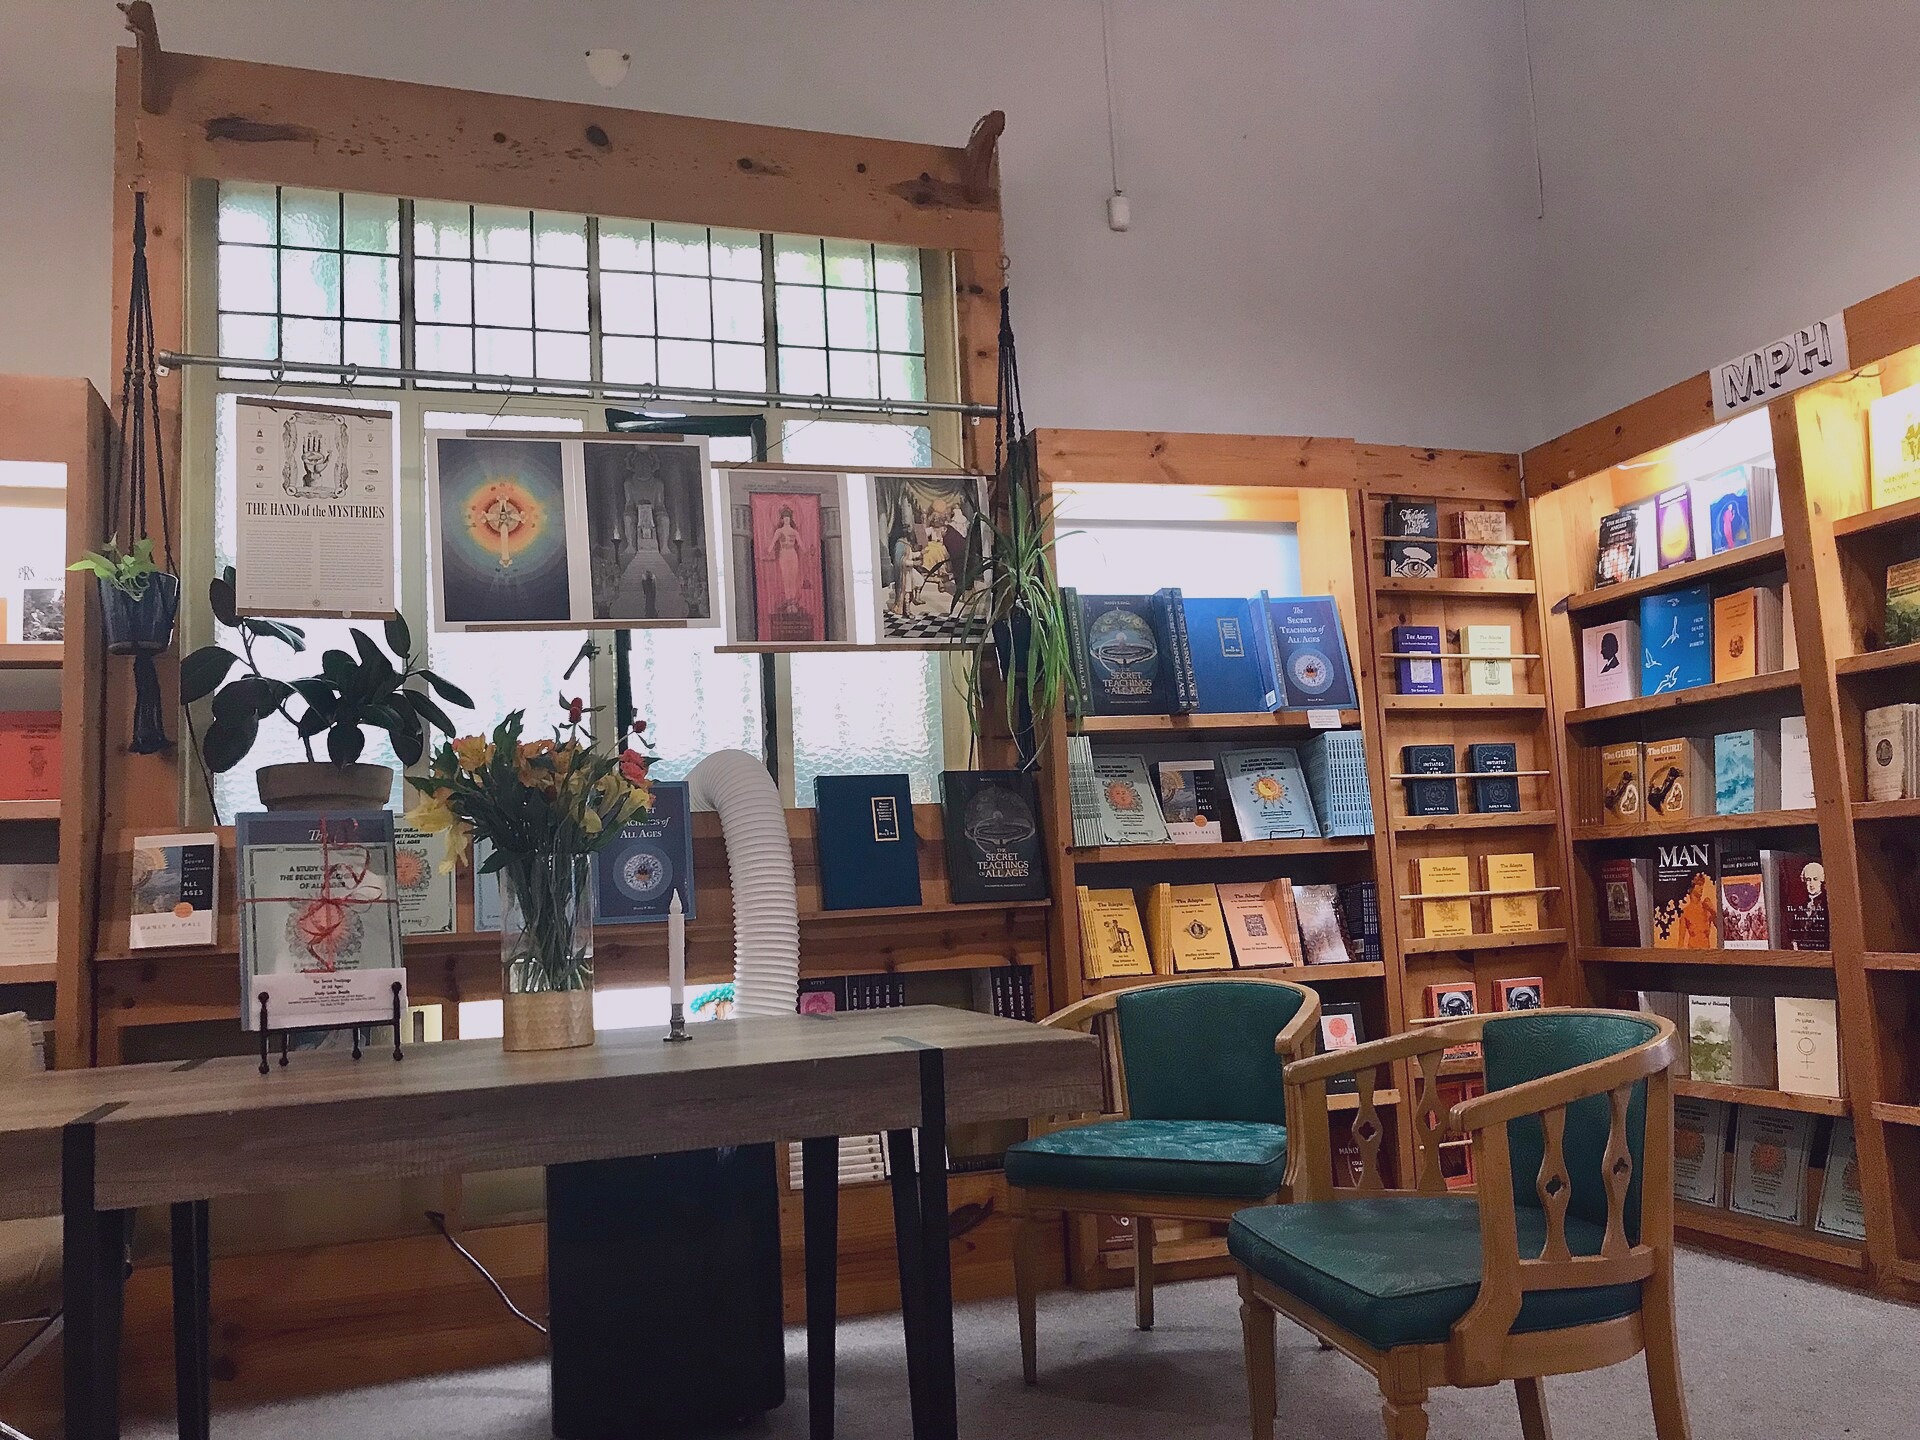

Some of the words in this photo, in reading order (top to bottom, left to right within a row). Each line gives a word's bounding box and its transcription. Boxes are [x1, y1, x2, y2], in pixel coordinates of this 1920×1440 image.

[1720, 321, 1833, 409] MPH
[245, 502, 268, 516] THE
[270, 502, 300, 517] HAND
[301, 504, 311, 517] of
[312, 504, 327, 517] the
[327, 504, 386, 519] MYSTERIES
[1292, 606, 1304, 614] The
[1286, 616, 1313, 624] SECRET
[1279, 626, 1317, 634] TEACHINGS
[1318, 625, 1326, 635] of
[1287, 636, 1301, 644] ALL
[1110, 671, 1143, 680] SECRET
[1102, 679, 1153, 687] TEACHINGS
[1110, 687, 1129, 695] ALL
[1129, 686, 1153, 695] AGES
[1660, 743, 1683, 754] GURU
[661, 817, 672, 828] of
[620, 829, 638, 839] ALL
[639, 829, 662, 838] AGES
[985, 852, 1019, 862] SECRET
[1658, 843, 1710, 868] MAN
[976, 860, 1029, 870] TEACHINGS
[985, 869, 1004, 878] ALL
[1004, 869, 1029, 877] AGES
